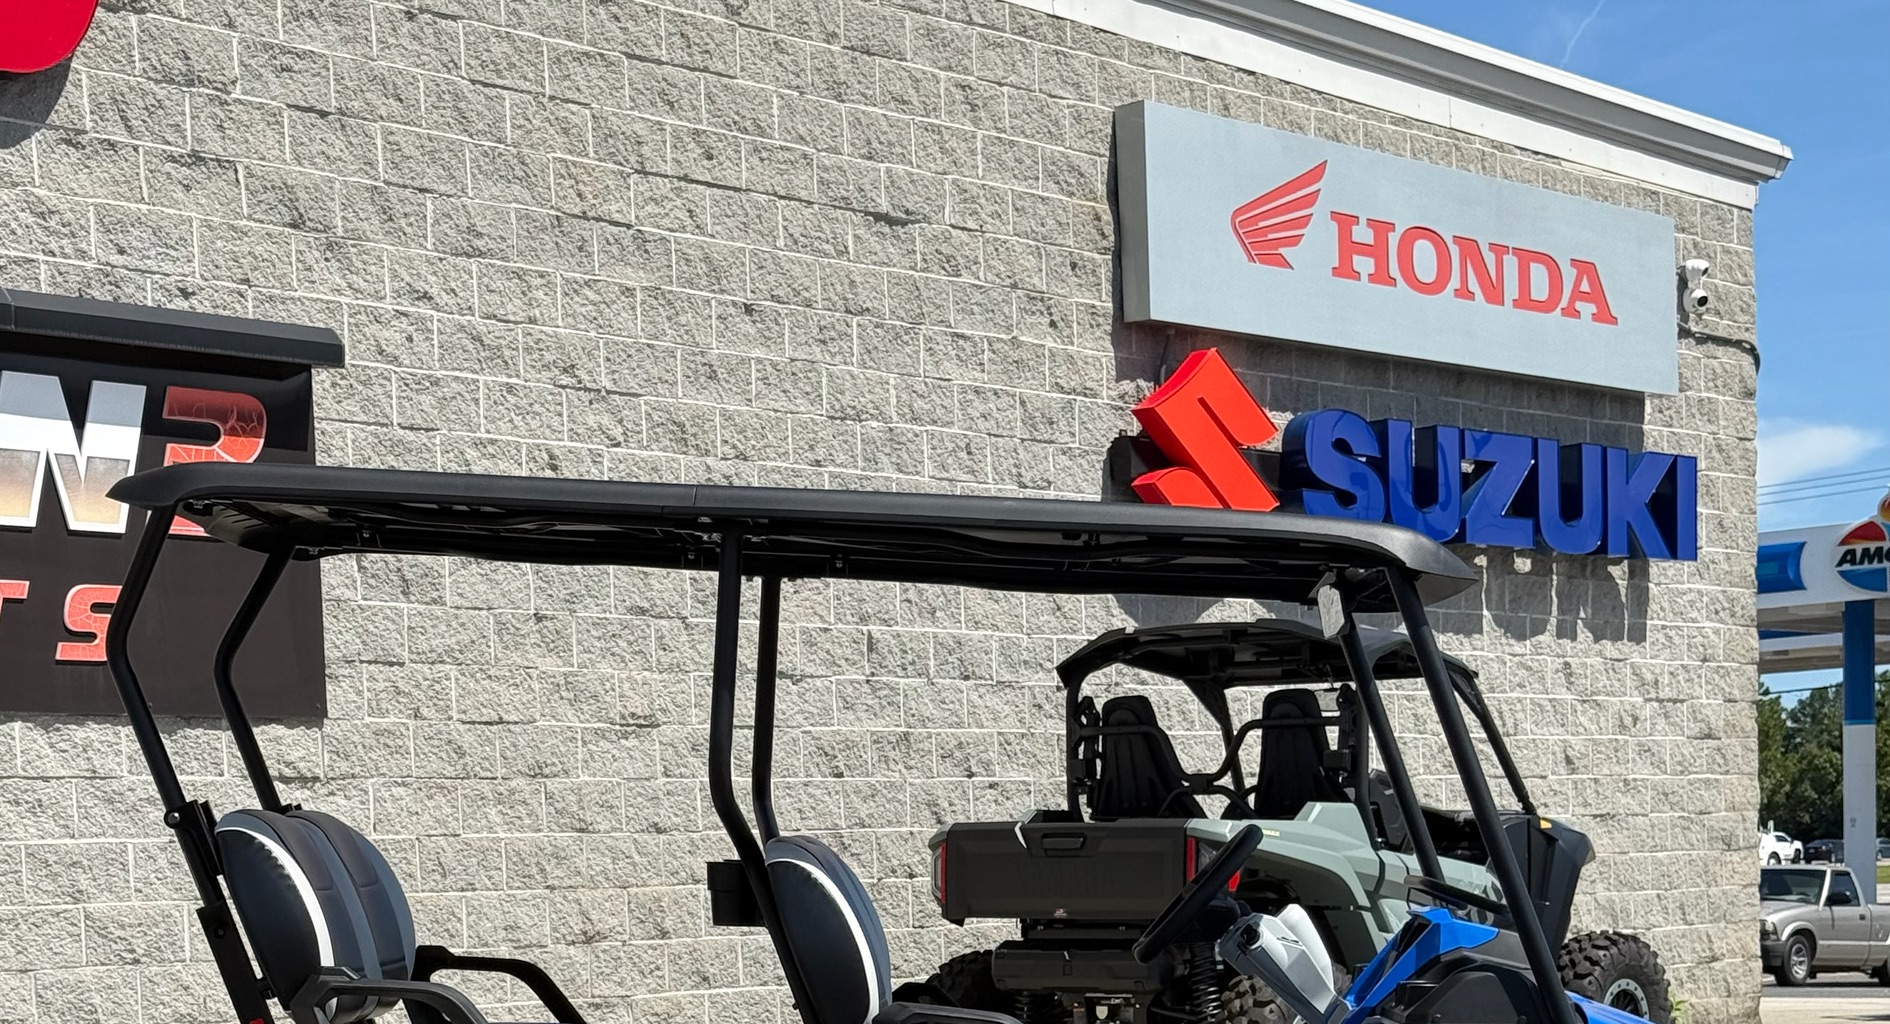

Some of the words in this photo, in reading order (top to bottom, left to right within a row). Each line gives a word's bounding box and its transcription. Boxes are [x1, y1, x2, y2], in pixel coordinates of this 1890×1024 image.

[1329, 210, 1619, 326] HONDA
[1283, 409, 1697, 562] SUZUKI
[1834, 545, 1890, 568] AM
